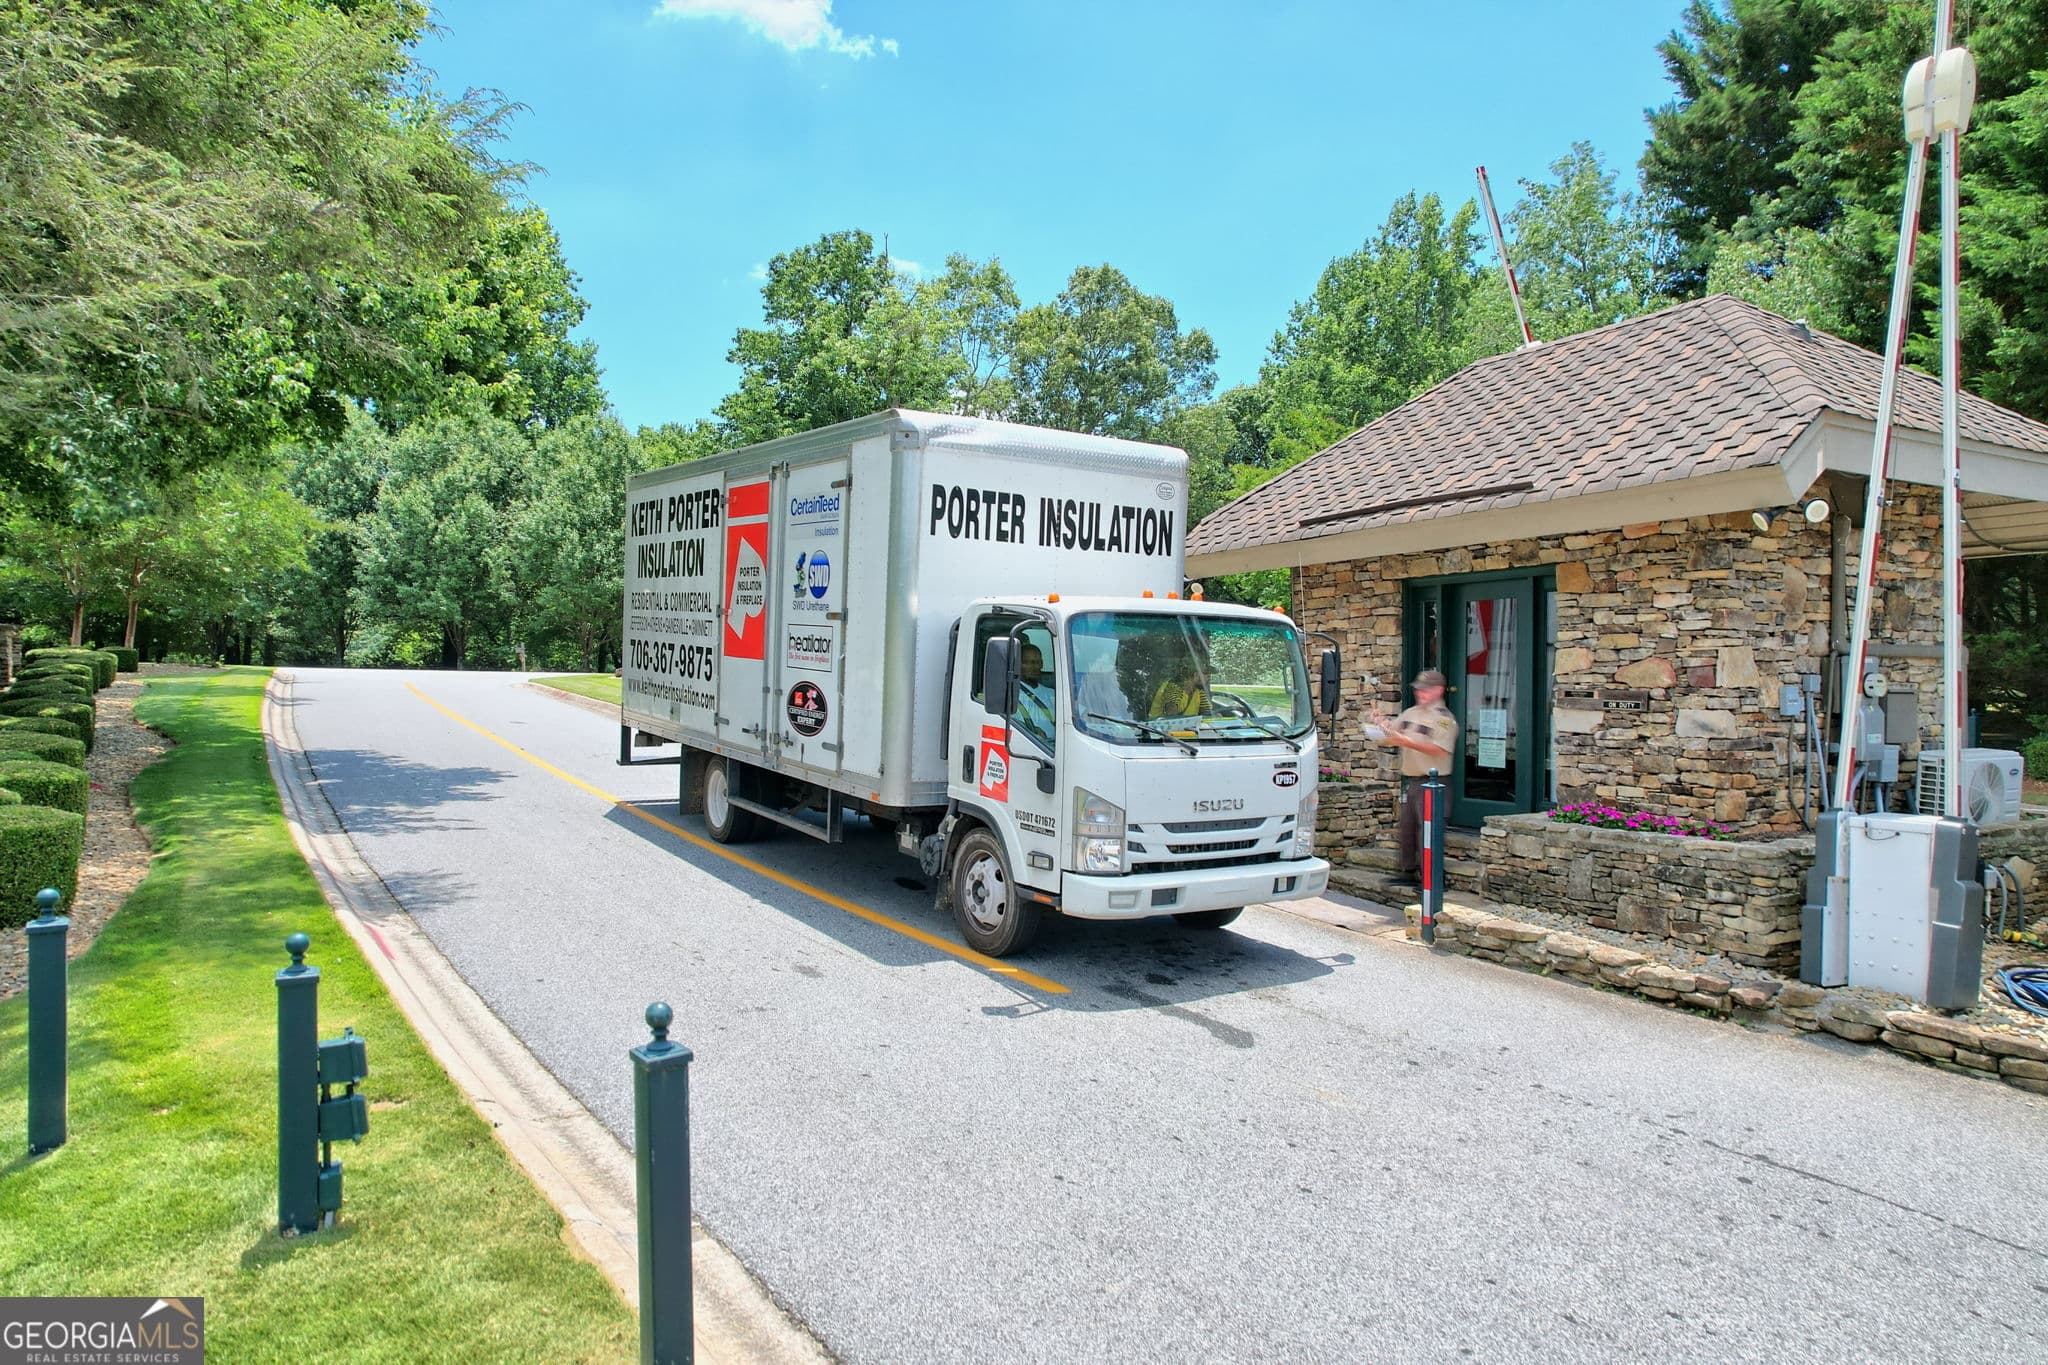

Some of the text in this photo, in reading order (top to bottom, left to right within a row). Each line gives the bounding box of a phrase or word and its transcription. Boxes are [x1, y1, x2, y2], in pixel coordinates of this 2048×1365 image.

[631, 488, 720, 537] KEITH PORTER
[791, 493, 839, 515] CertainTeed
[930, 484, 1173, 556] PORTER INSULATION
[638, 538, 705, 579] INSULATION
[740, 566, 760, 577] PORTER
[809, 564, 829, 588] SWD
[737, 580, 762, 591] INSULATION
[631, 592, 712, 613] RESIDENTIAL & COMMERCIAL
[740, 595, 763, 606] FIREPLACE
[630, 639, 713, 682] 706-367-9875
[1193, 798, 1244, 812] ISUZU
[1015, 809, 1033, 823] USDOT
